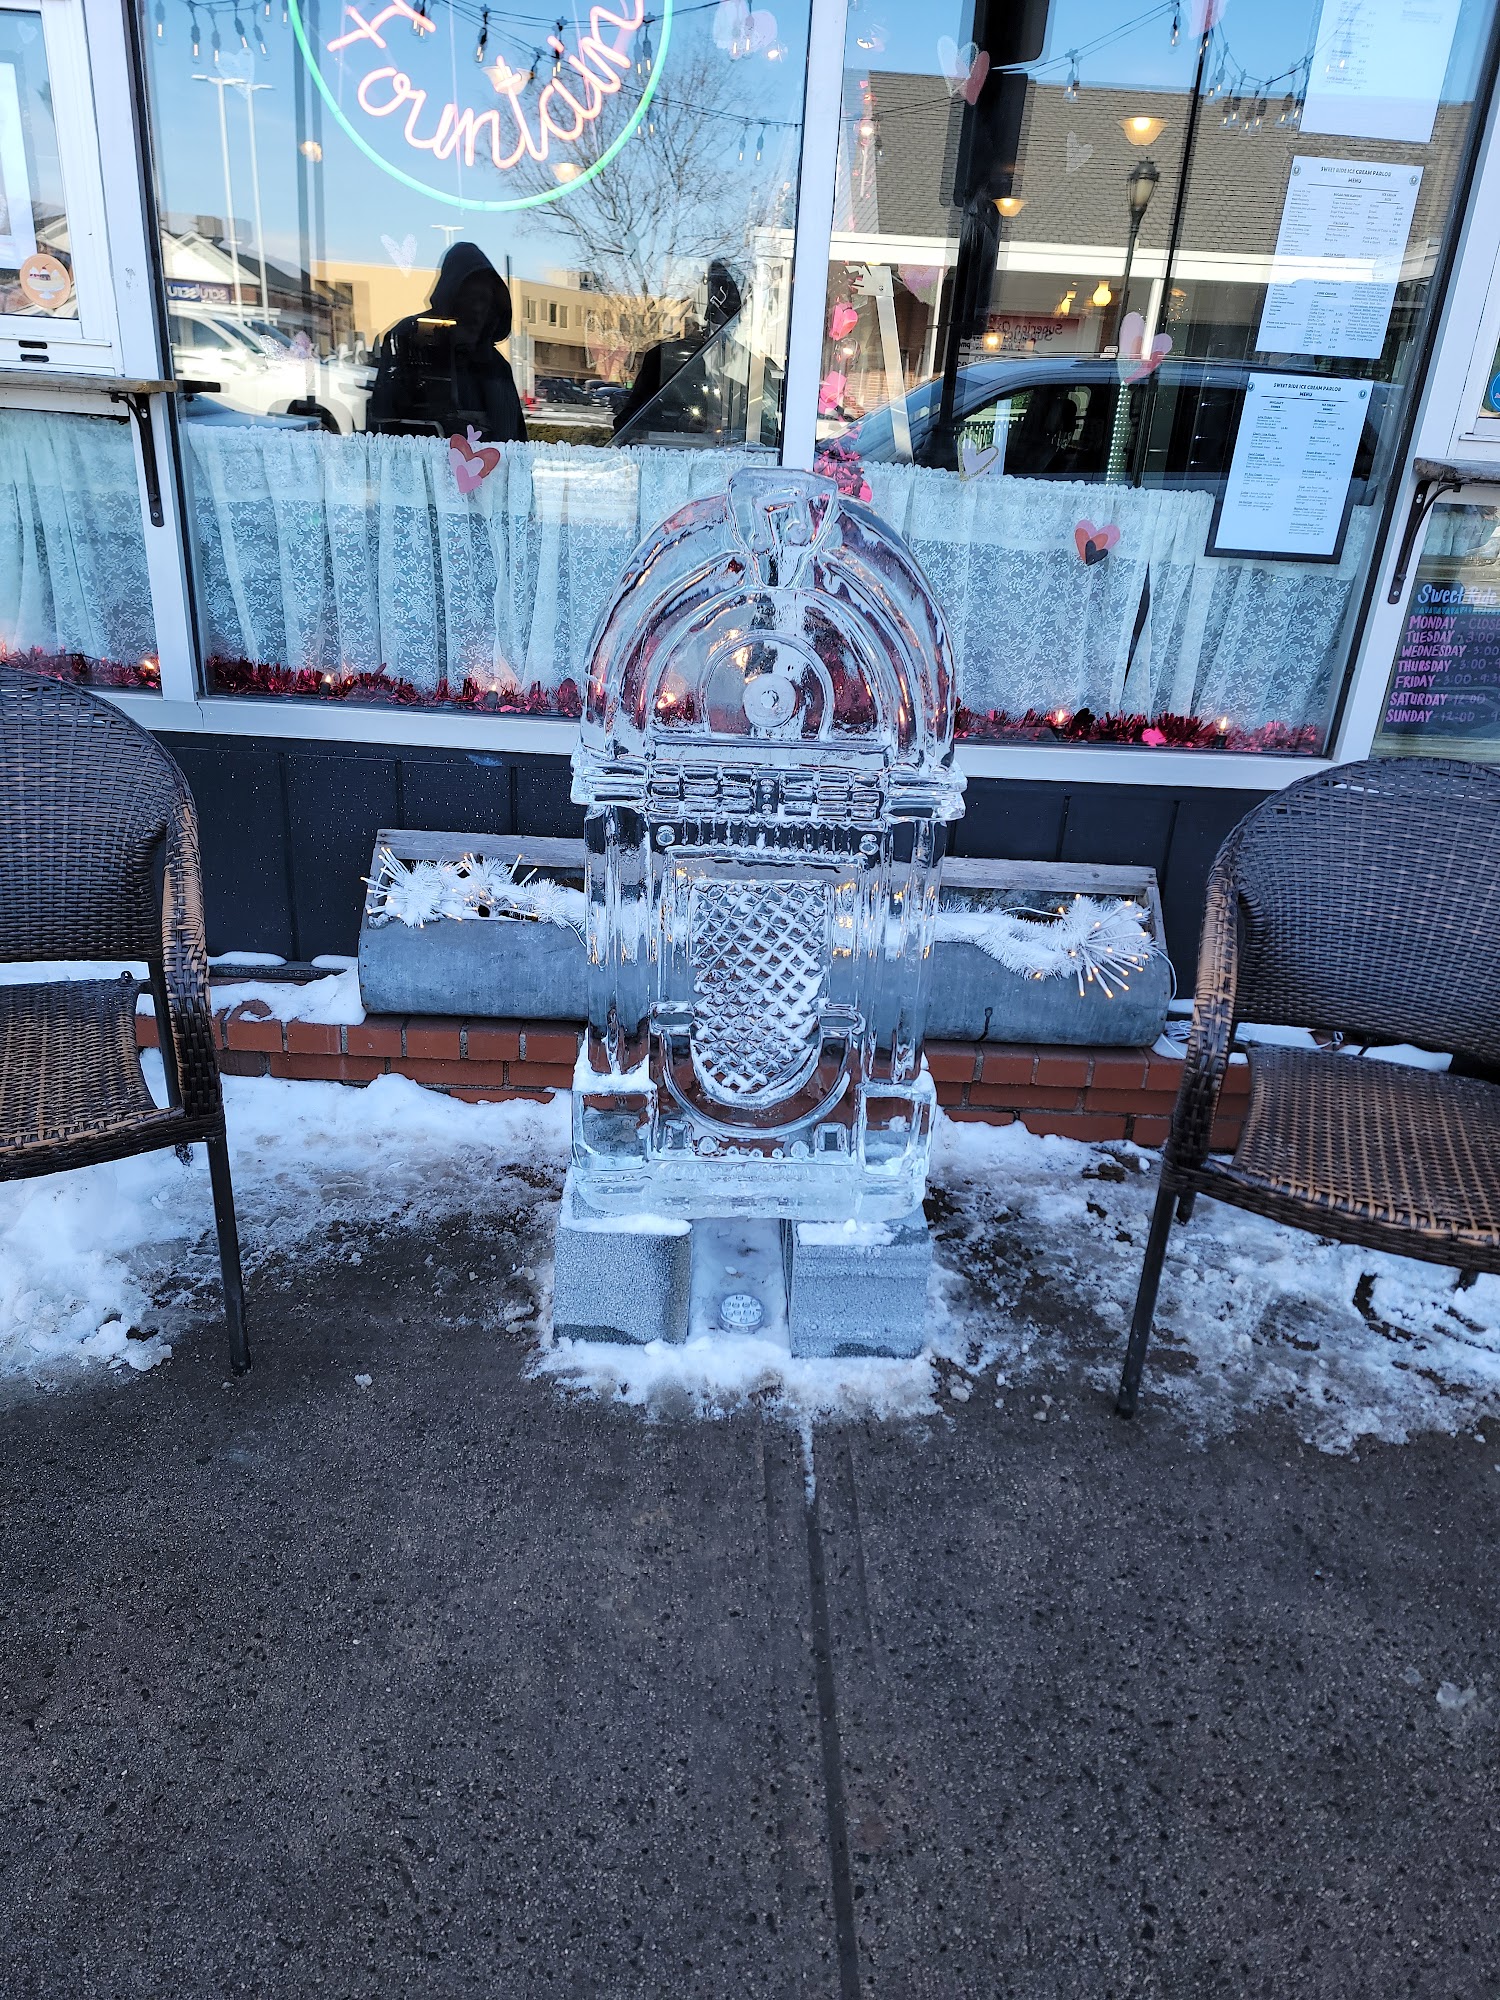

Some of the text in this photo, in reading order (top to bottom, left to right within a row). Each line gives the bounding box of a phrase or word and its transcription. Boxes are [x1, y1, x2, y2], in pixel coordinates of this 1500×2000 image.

[1417, 583, 1465, 604] Sweet
[1408, 615, 1457, 630] MONDAY
[1405, 630, 1455, 644] TUESDAY
[1401, 644, 1467, 657] WEDNESDAY
[1397, 659, 1452, 673] THURSDAY
[1459, 658, 1487, 670] 3:00
[1394, 674, 1436, 689] FRIDAY
[1443, 674, 1472, 686] 3:00
[1389, 691, 1448, 706] SATURDAY
[1385, 709, 1433, 723] SUNDAY
